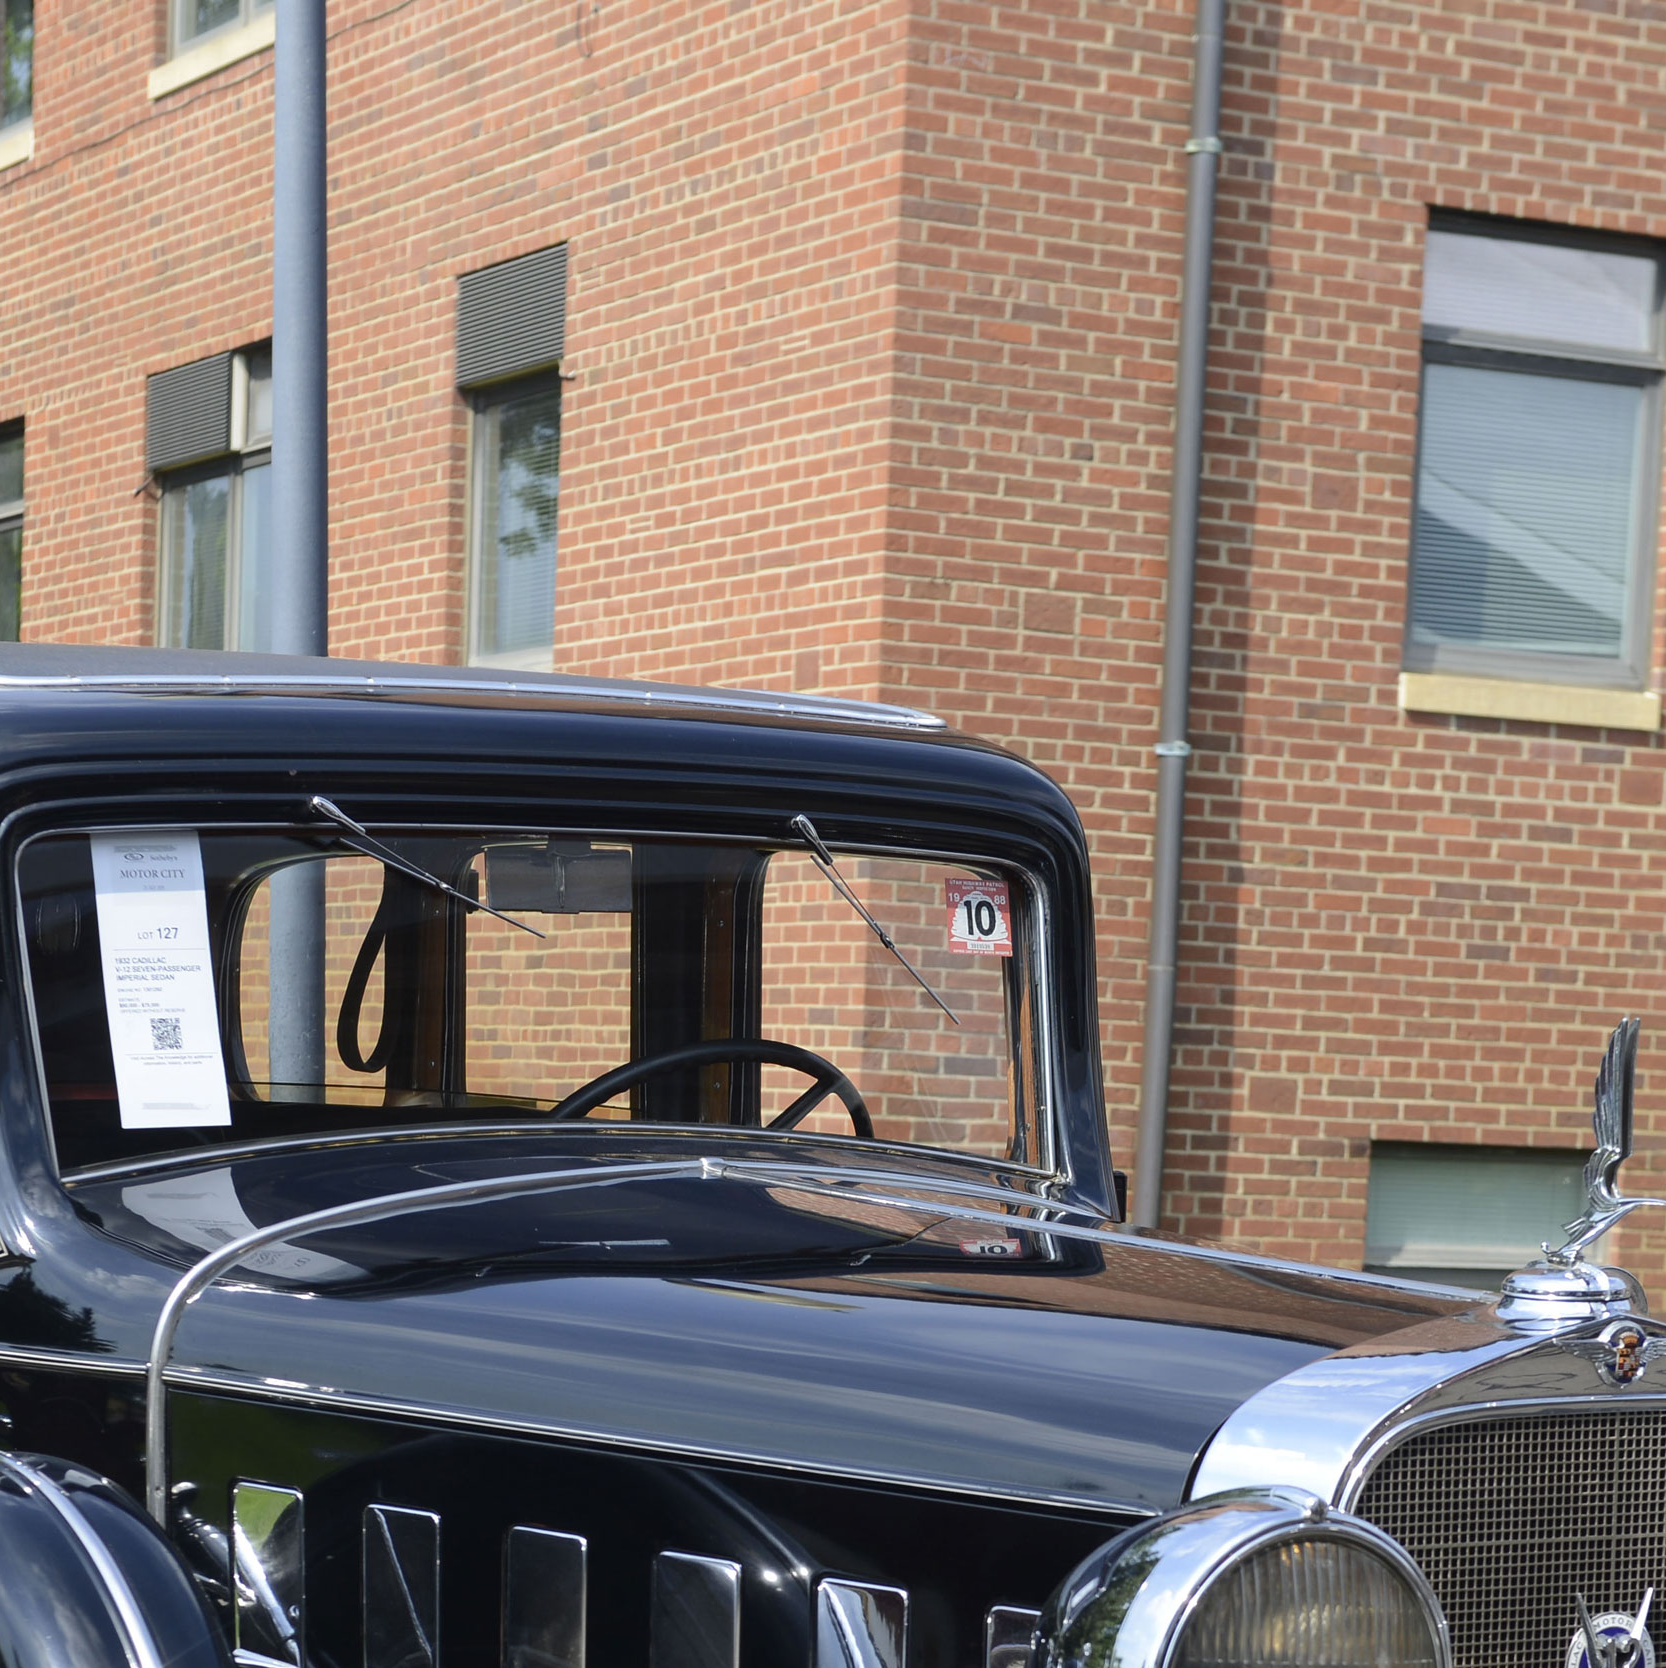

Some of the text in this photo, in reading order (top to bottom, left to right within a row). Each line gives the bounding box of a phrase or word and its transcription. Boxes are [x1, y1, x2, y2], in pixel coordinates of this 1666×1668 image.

[120, 869, 185, 879] MOTOR CITY
[948, 892, 1006, 905] 19 88
[963, 900, 997, 937] 10
[137, 927, 179, 940] LOT 127
[132, 965, 202, 973] SEVEN-PASSENGER
[1593, 1617, 1632, 1629] MOTOR
[1643, 1639, 1652, 1666] CAR
